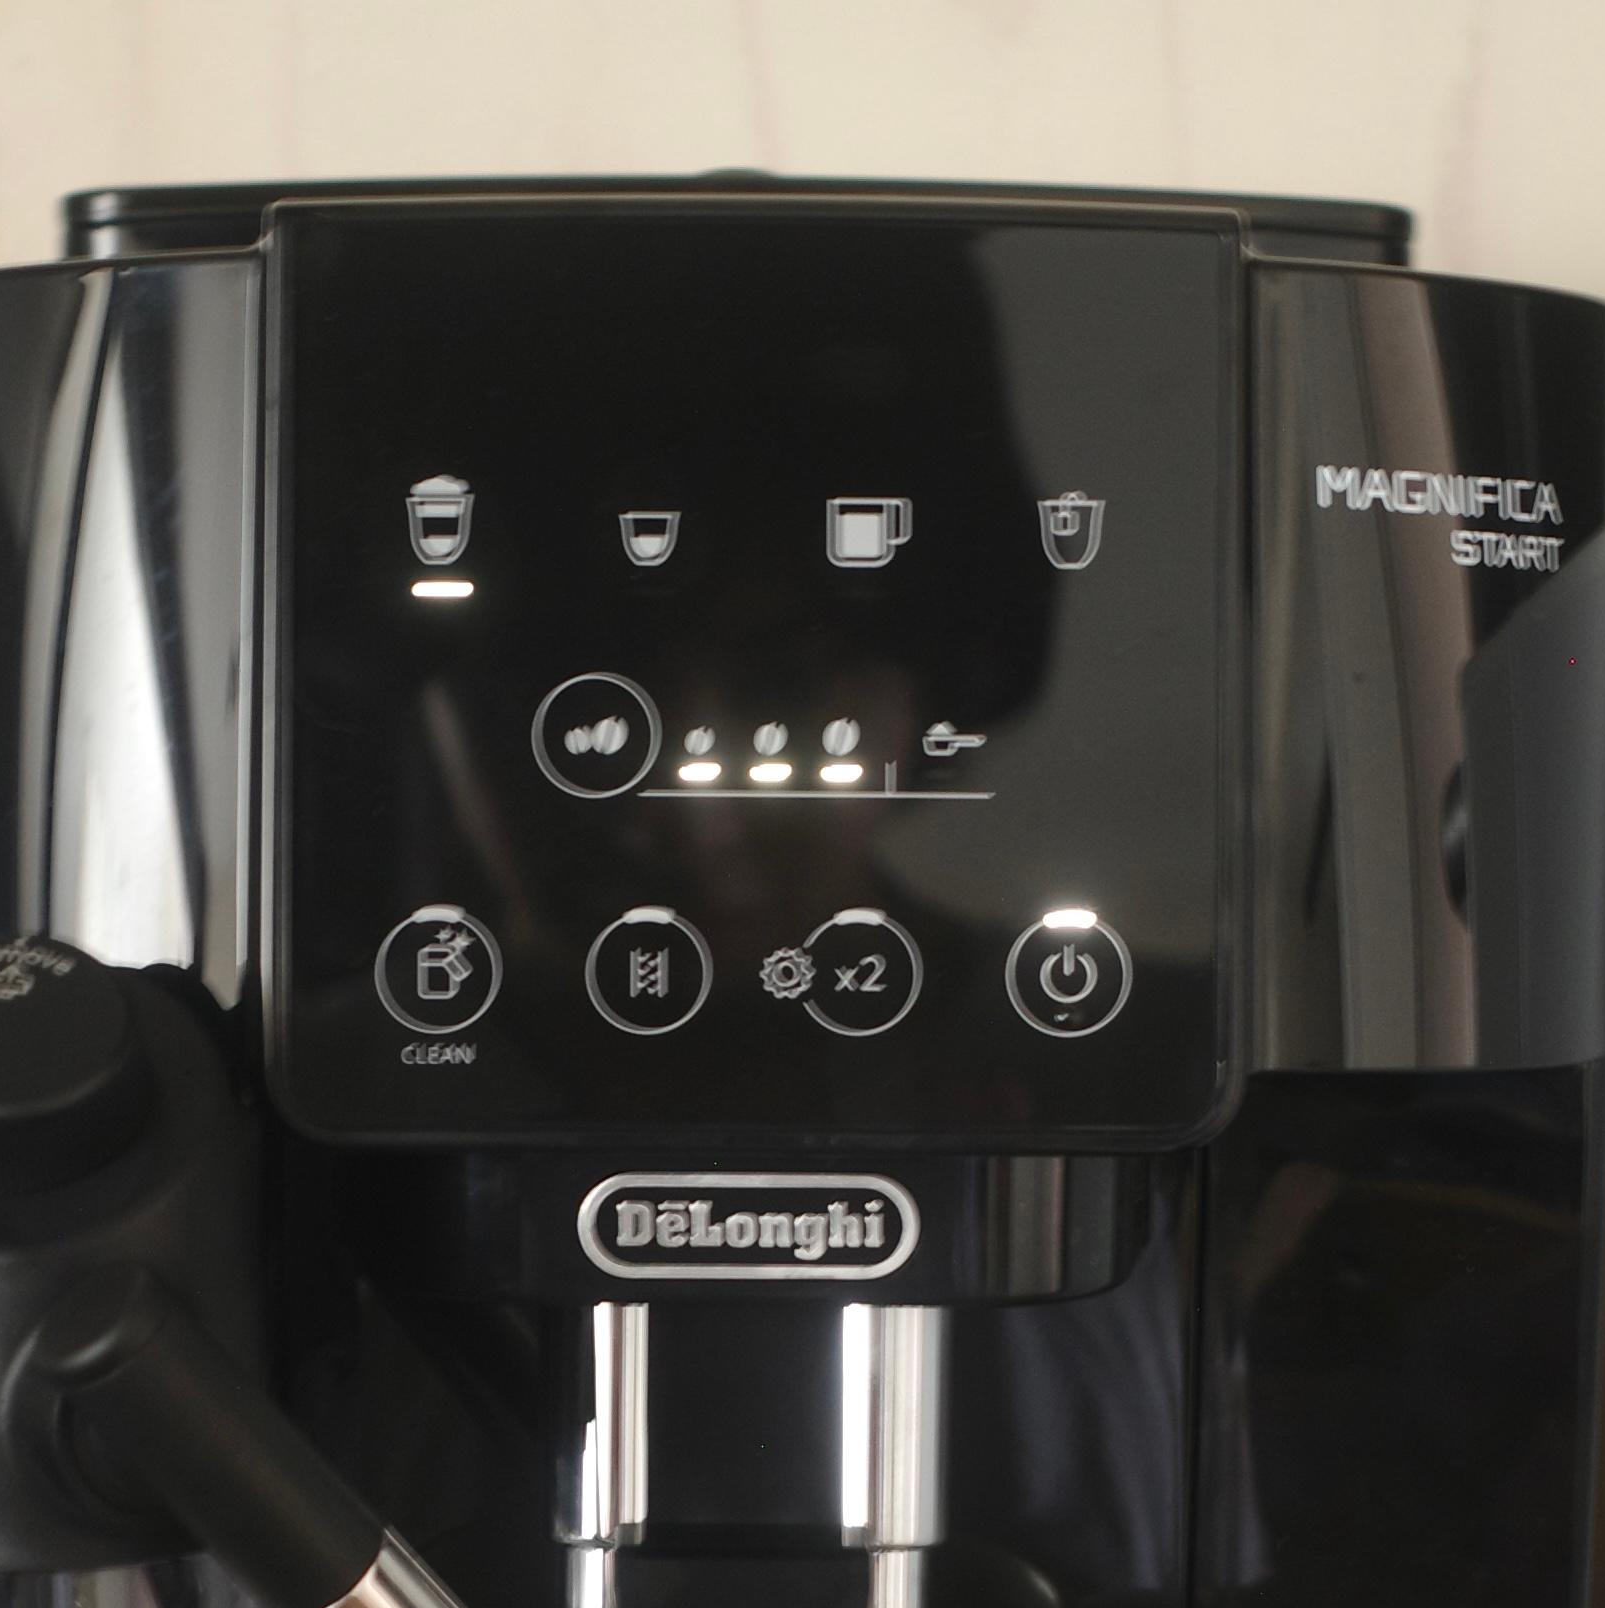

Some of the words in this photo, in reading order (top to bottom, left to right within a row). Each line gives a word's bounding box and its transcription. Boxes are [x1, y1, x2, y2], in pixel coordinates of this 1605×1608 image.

[1315, 464, 1564, 525] MAGNIFICA
[1450, 529, 1565, 573] START
[400, 1042, 477, 1065] CLEAN
